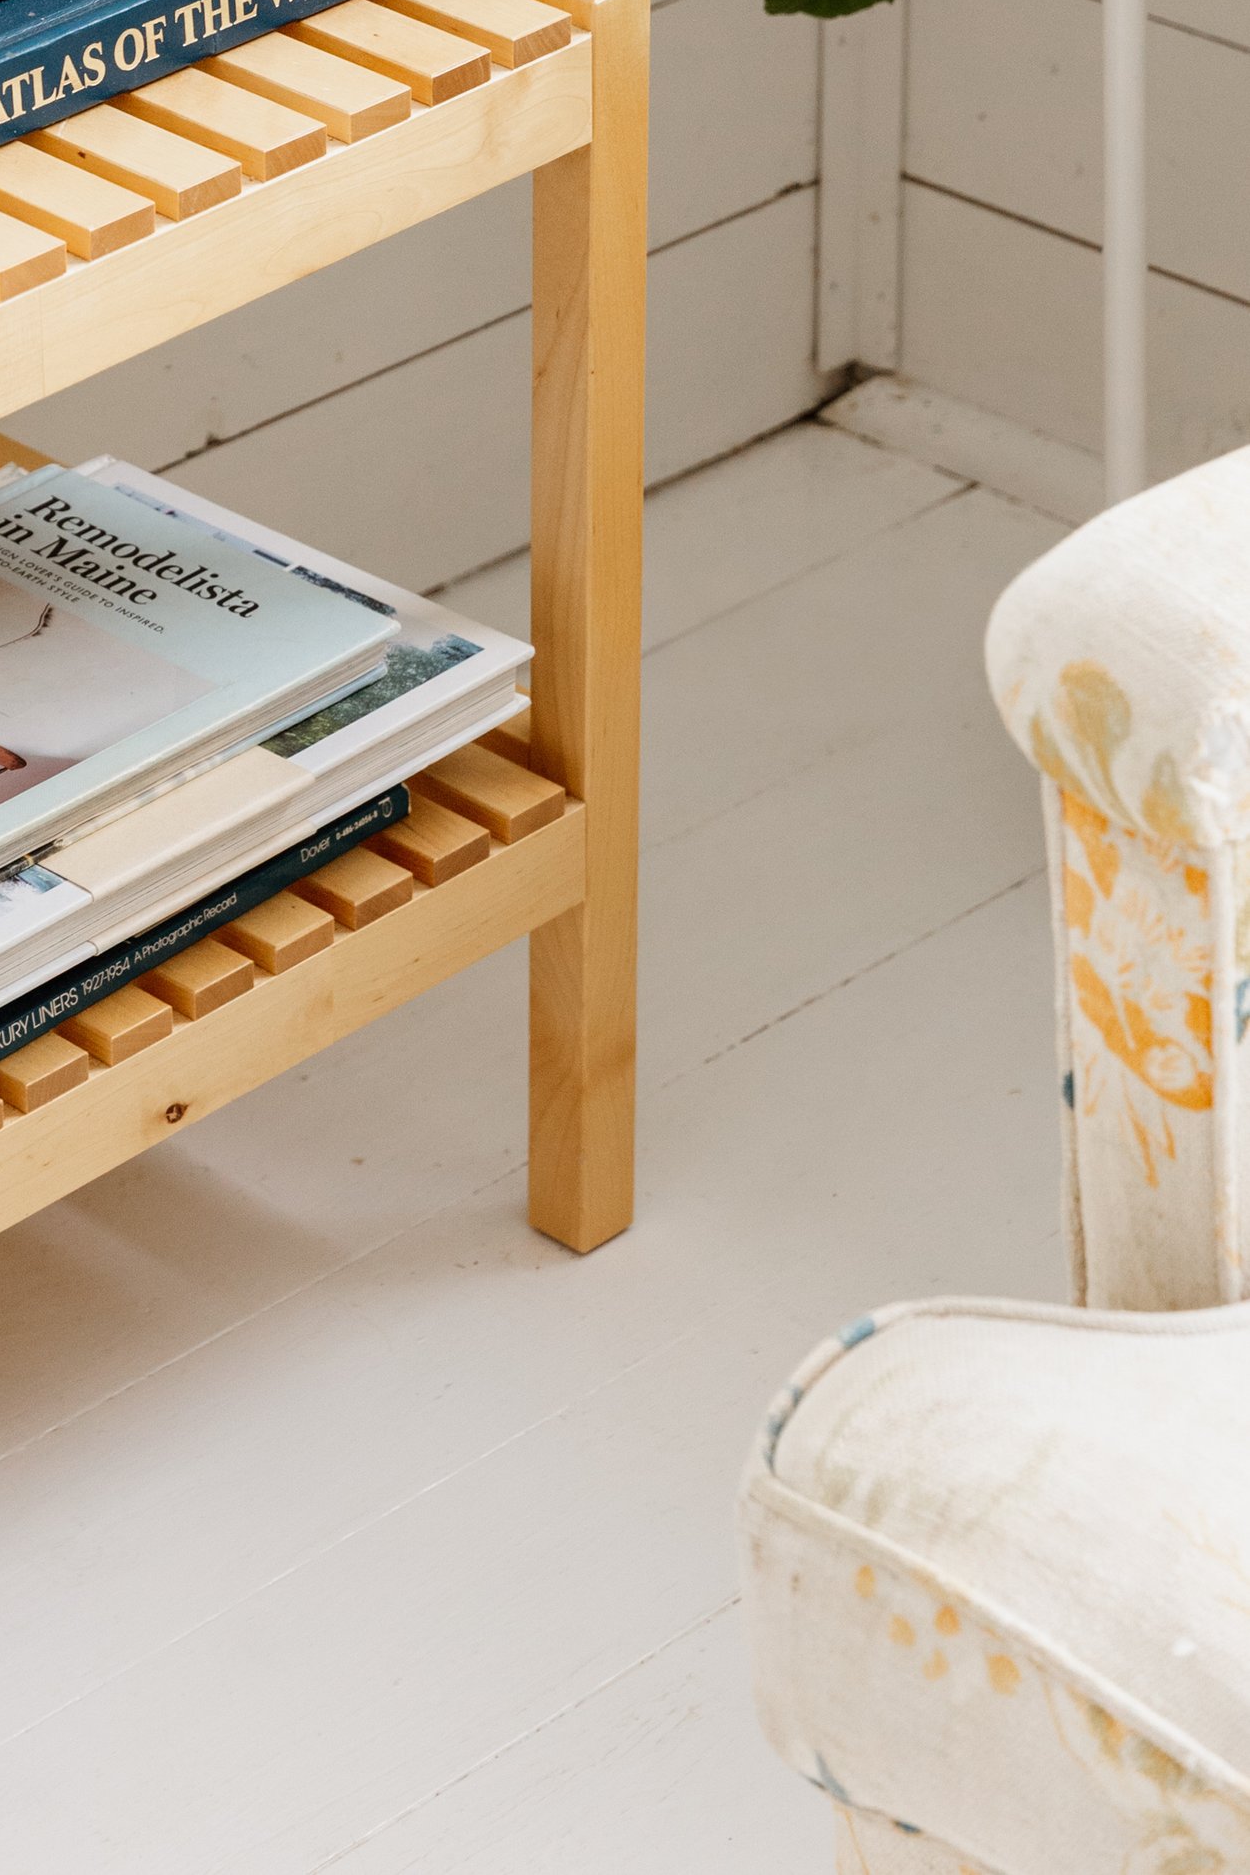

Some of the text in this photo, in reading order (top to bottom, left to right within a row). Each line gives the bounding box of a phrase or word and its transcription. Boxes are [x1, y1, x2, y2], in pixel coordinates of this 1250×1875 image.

[114, 15, 167, 72] OF
[17, 556, 62, 583] LOVER'S
[63, 578, 98, 601] GUIDE
[99, 596, 115, 609] TO
[24, 495, 260, 619] Remodelista
[30, 534, 158, 606] Maine
[46, 582, 81, 605] STYLE
[300, 836, 331, 864] Dover
[133, 892, 238, 965] A Photographic Record
[31, 987, 79, 1029] LINERS
[80, 956, 131, 996] 1927-1954
